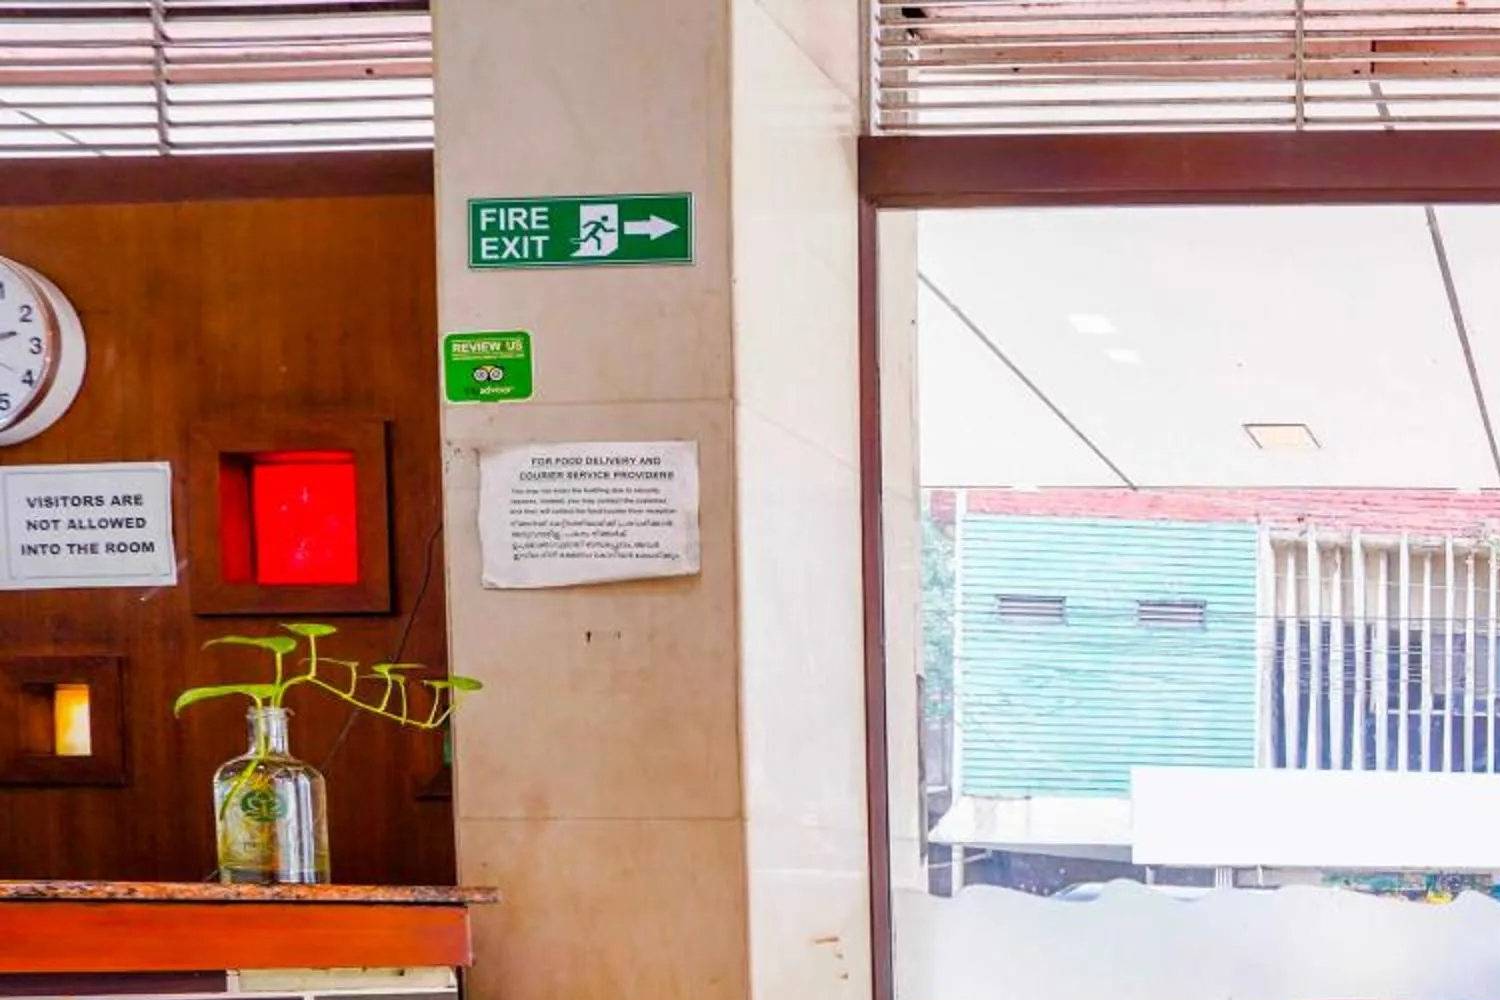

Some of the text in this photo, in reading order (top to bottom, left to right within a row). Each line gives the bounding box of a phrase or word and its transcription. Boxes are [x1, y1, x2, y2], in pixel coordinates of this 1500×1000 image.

[480, 206, 549, 231] FIRE
[480, 236, 549, 260] EXIT
[19, 304, 33, 323] 2
[29, 337, 42, 355] 3
[452, 341, 500, 353] REVIEW
[21, 369, 34, 387] 4
[0, 393, 11, 411] 5
[531, 456, 662, 466] FOR FOOD DELIVERY AND
[26, 494, 144, 509] VISITORS ARE
[25, 517, 147, 531] NOT ALLOWED
[20, 541, 155, 555] INTO THE ROOM
